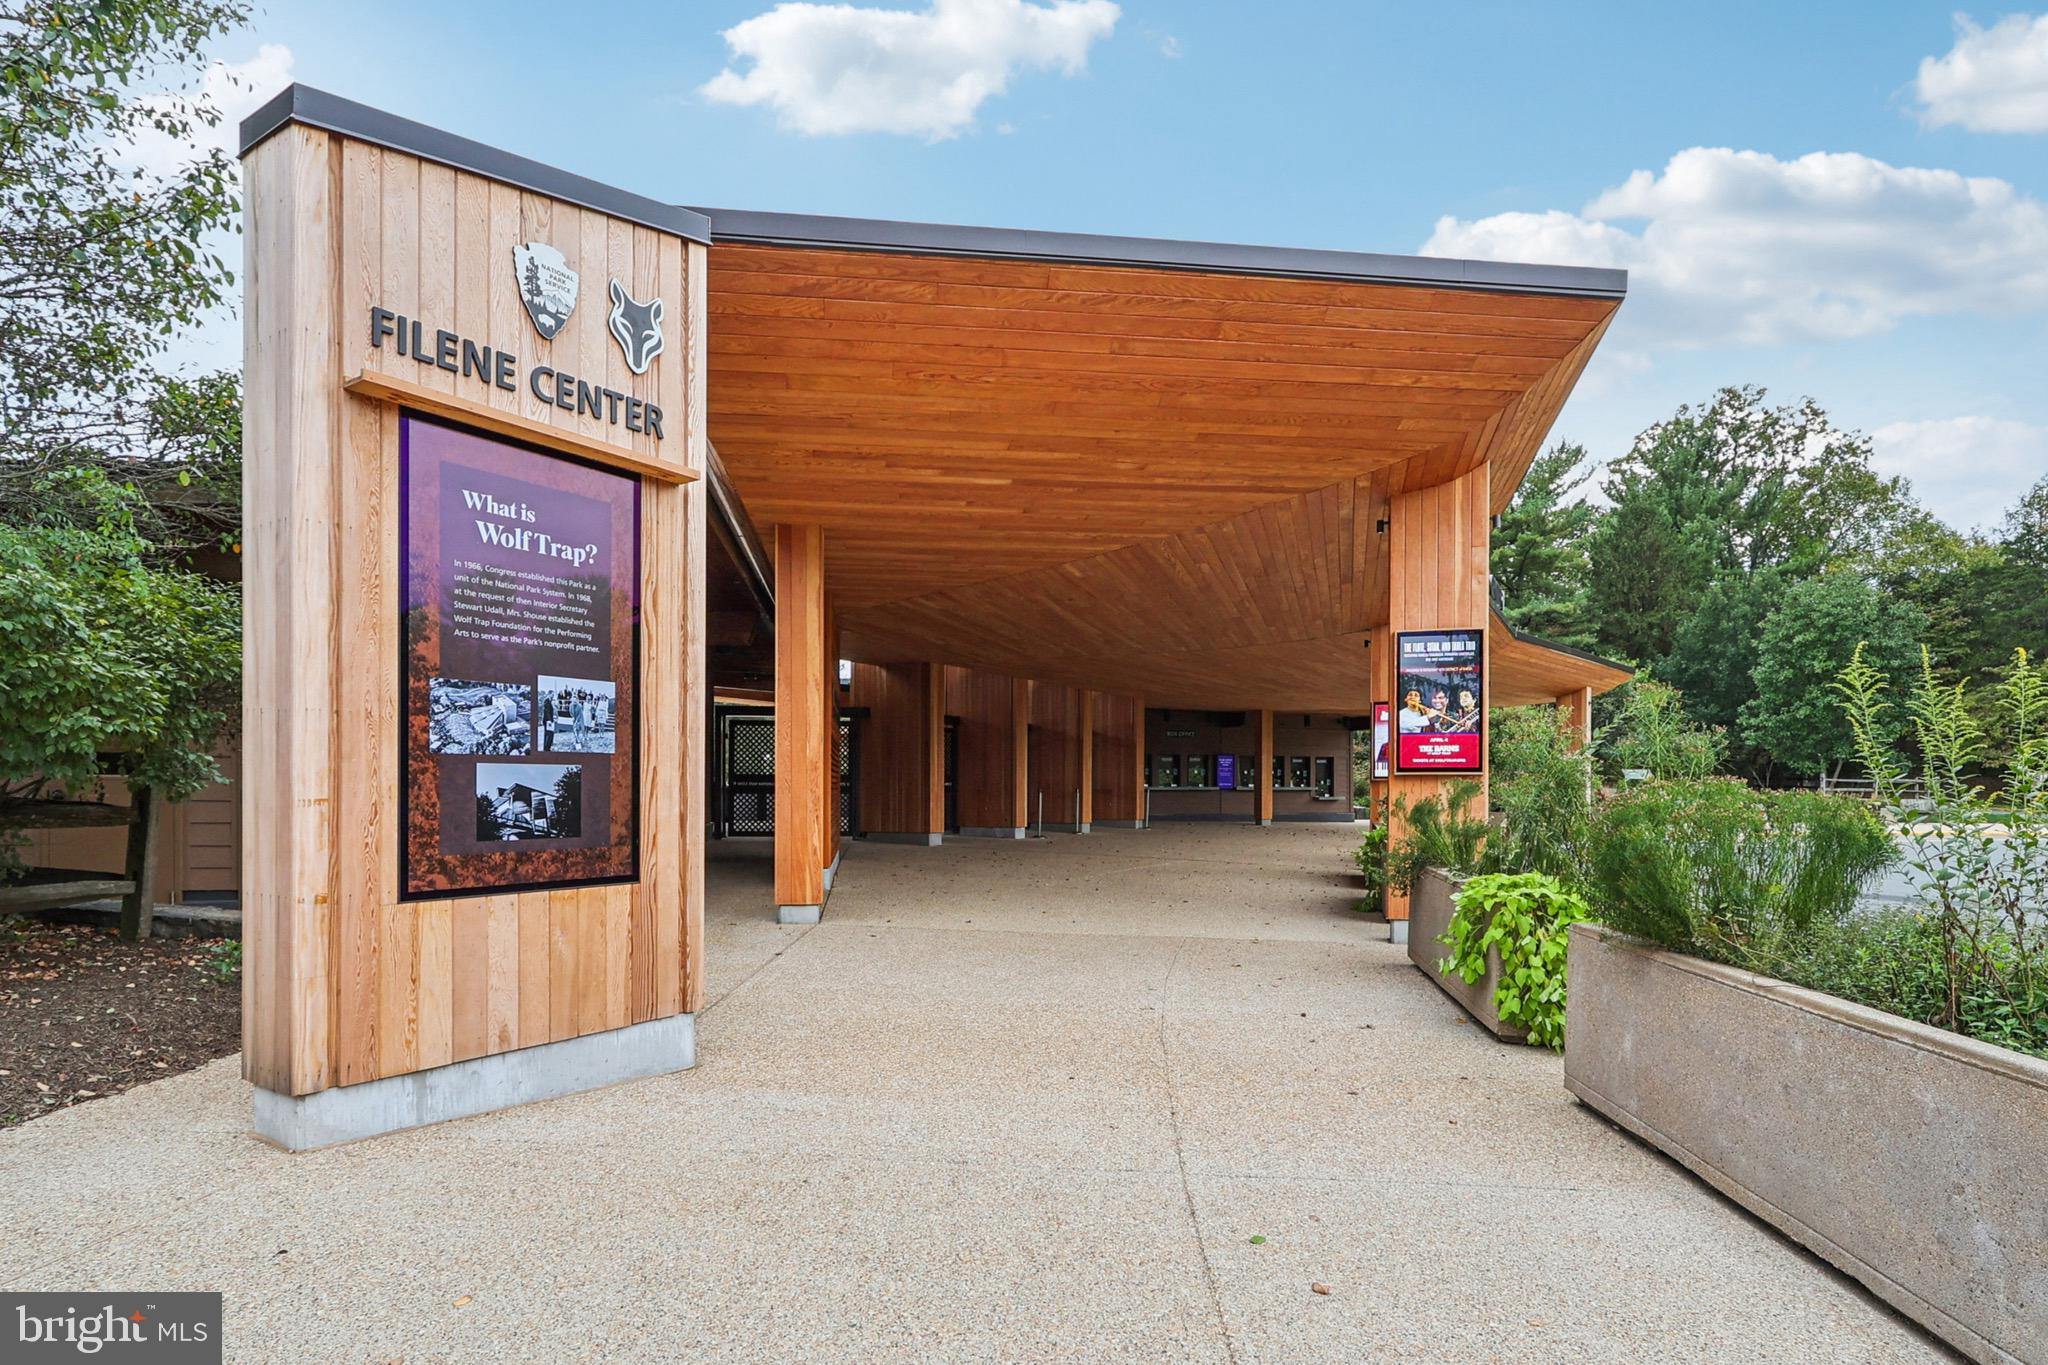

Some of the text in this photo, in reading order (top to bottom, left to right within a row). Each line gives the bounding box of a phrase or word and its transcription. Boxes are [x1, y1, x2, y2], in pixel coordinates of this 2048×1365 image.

[541, 263, 574, 282] NATIONAL
[549, 273, 567, 285] PARK
[544, 278, 571, 294] SERVICE
[372, 306, 664, 440] FILENE CENTER
[462, 489, 536, 523] What is
[475, 520, 598, 567] Wolf Trap?
[453, 559, 462, 568] In
[464, 561, 483, 572] 1966,
[485, 565, 517, 577] Congress
[517, 571, 555, 584] established
[556, 577, 568, 586] this
[569, 580, 583, 588] Park
[454, 574, 469, 583] unit
[471, 576, 479, 584] of
[481, 578, 493, 586] the
[495, 580, 525, 591] National
[526, 585, 541, 594] Park
[542, 588, 566, 599] System.
[453, 601, 595, 628] Stewart Udall, Mrs. Shouse established the
[464, 589, 477, 597] the
[478, 592, 505, 602] request
[506, 595, 515, 603] of
[516, 597, 532, 605] then
[533, 600, 557, 609] Interior
[559, 604, 588, 615] Secretary
[453, 614, 473, 624] Wolf
[474, 617, 490, 627] Trap
[491, 620, 531, 632] Foundation
[544, 627, 556, 635] the
[557, 628, 592, 641] Performing
[453, 628, 470, 638] Arts
[471, 631, 480, 639] to
[480, 633, 500, 641] serve
[510, 635, 522, 644] the
[523, 637, 543, 646] Park's
[544, 640, 575, 650] nonprofit
[576, 644, 600, 653] partner.
